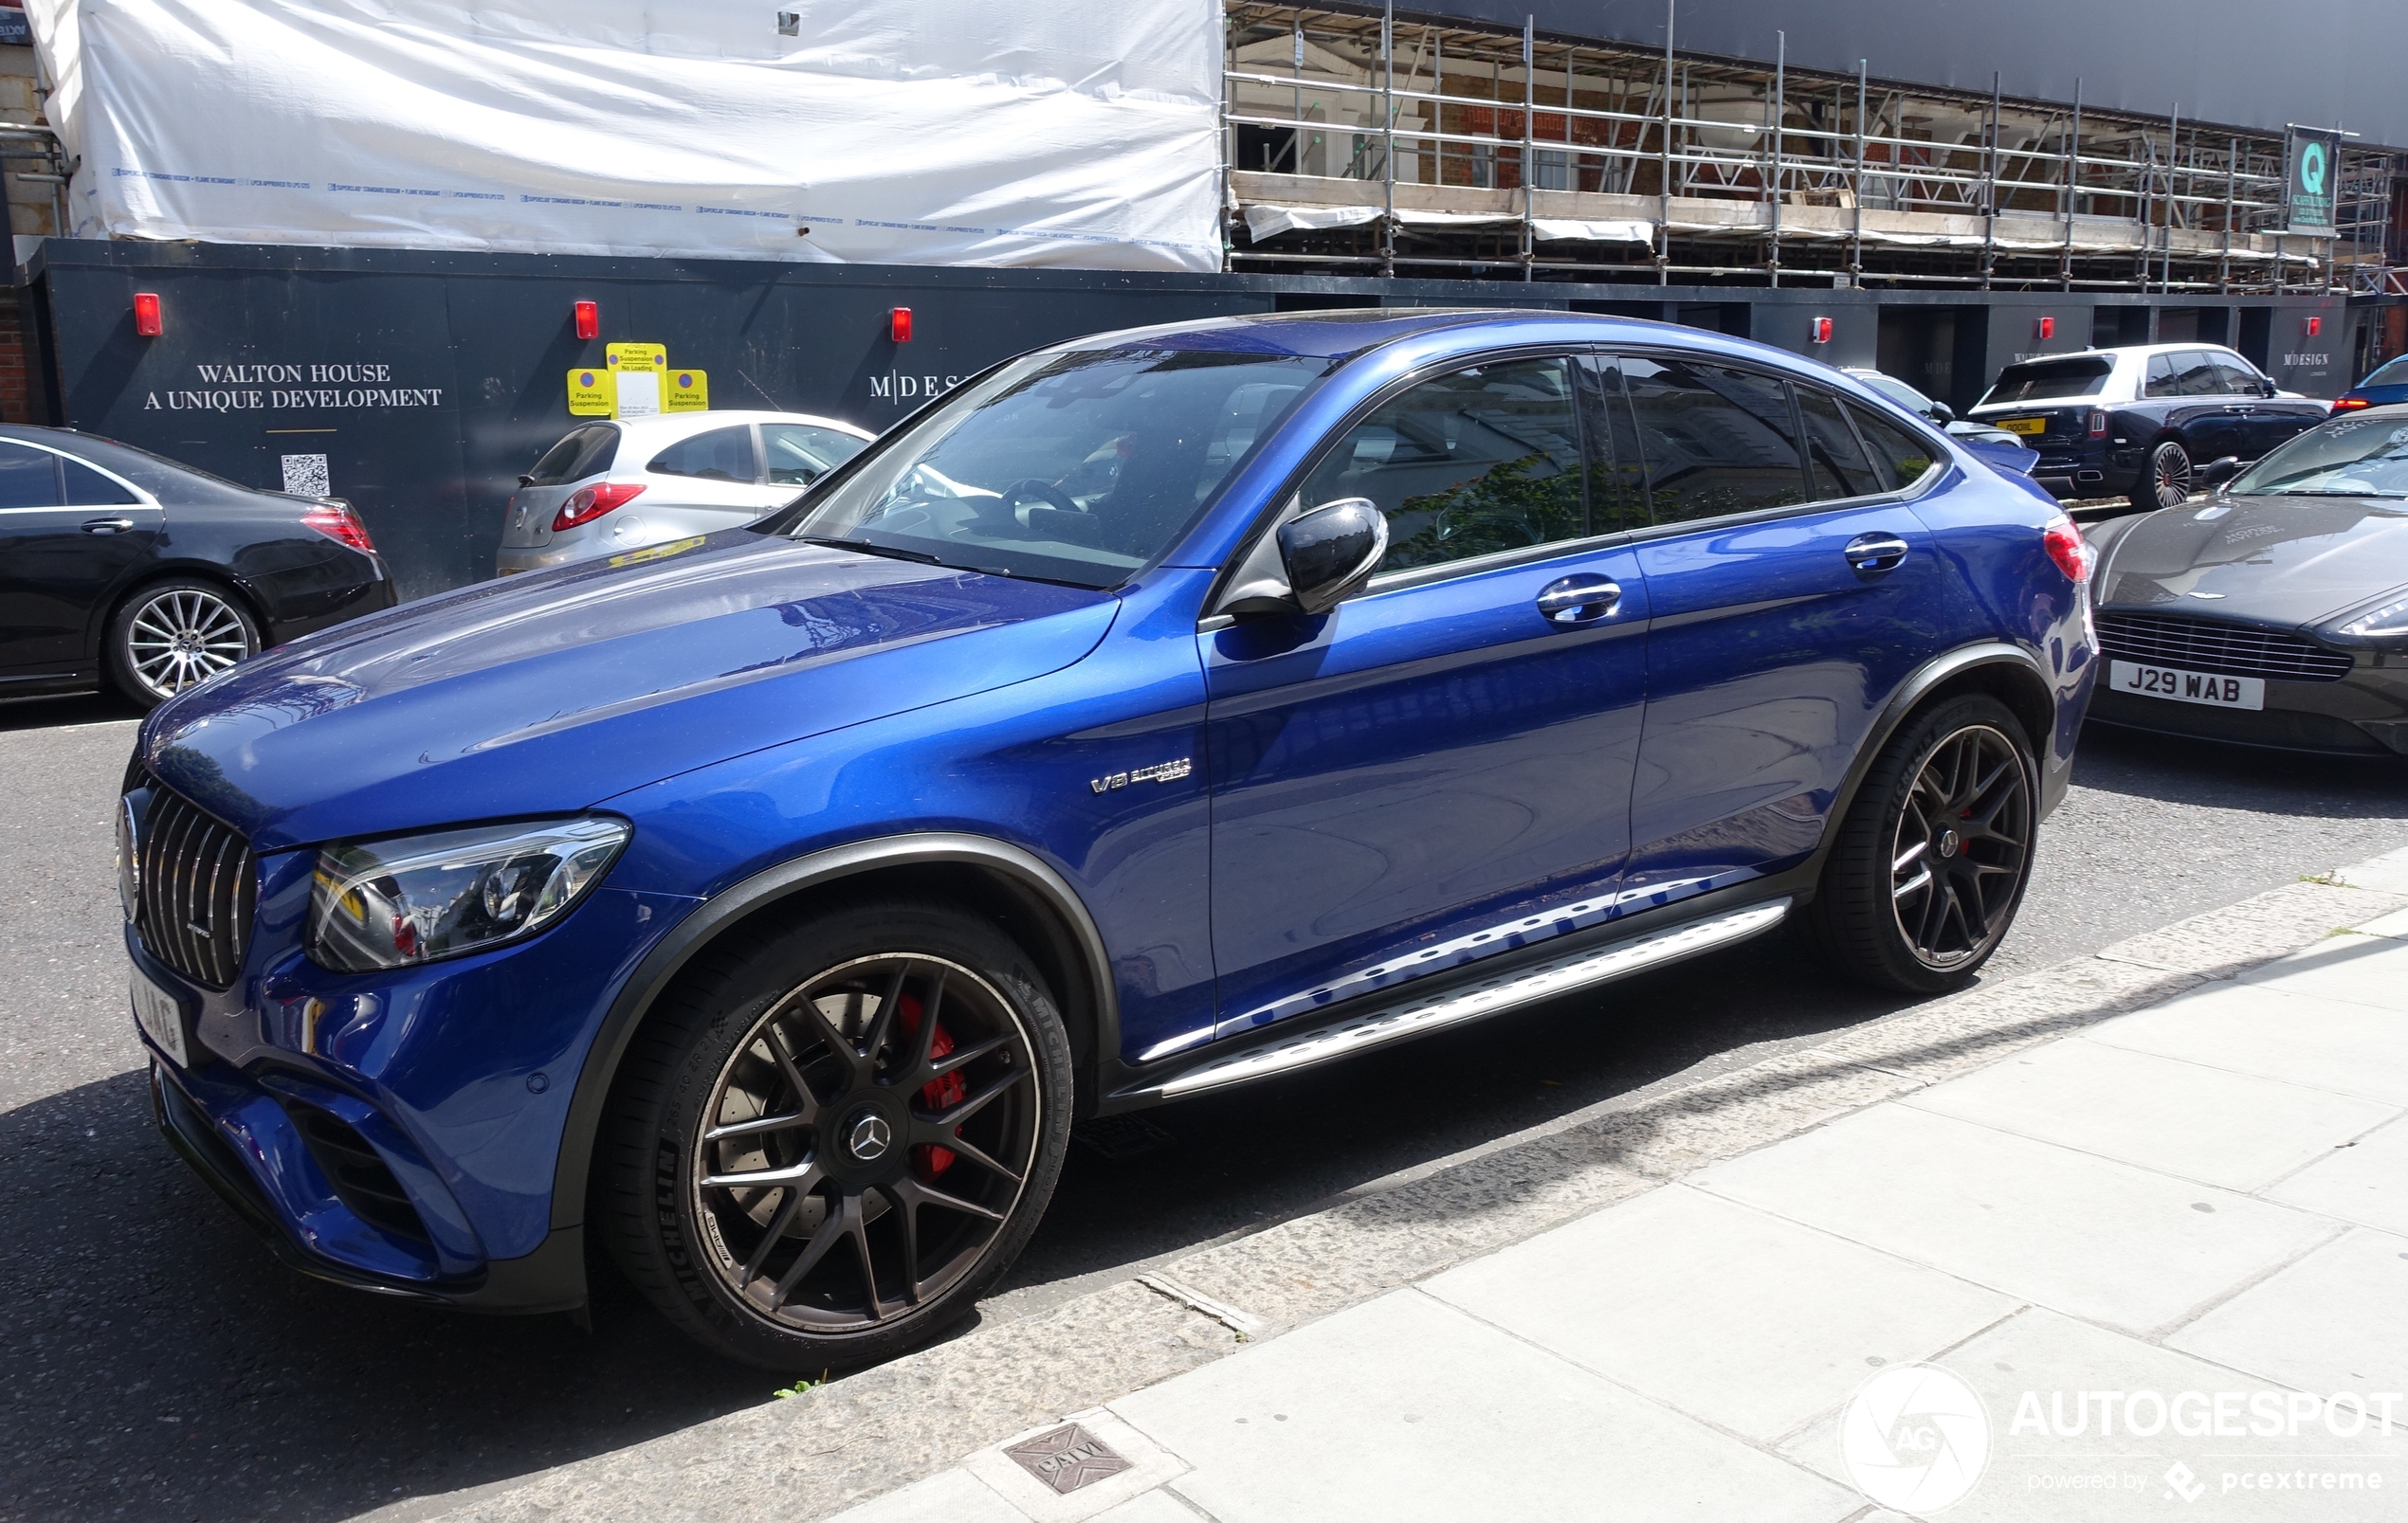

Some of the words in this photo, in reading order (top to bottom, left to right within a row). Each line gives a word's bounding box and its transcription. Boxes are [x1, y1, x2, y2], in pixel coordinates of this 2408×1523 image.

[2301, 142, 2326, 195] Q
[197, 364, 301, 384] WALTON
[311, 364, 391, 383] HOUSE
[144, 391, 162, 409] A
[167, 390, 265, 413] UNIQUE
[271, 389, 442, 408] DEVELOPMENT
[2128, 667, 2177, 695] J29
[2185, 674, 2240, 702] WAB
[1090, 772, 1128, 793] V8
[688, 1052, 702, 1072] ZR
[1031, 997, 1067, 1136] MICHELIN
[657, 1151, 709, 1301] MICHELIN
